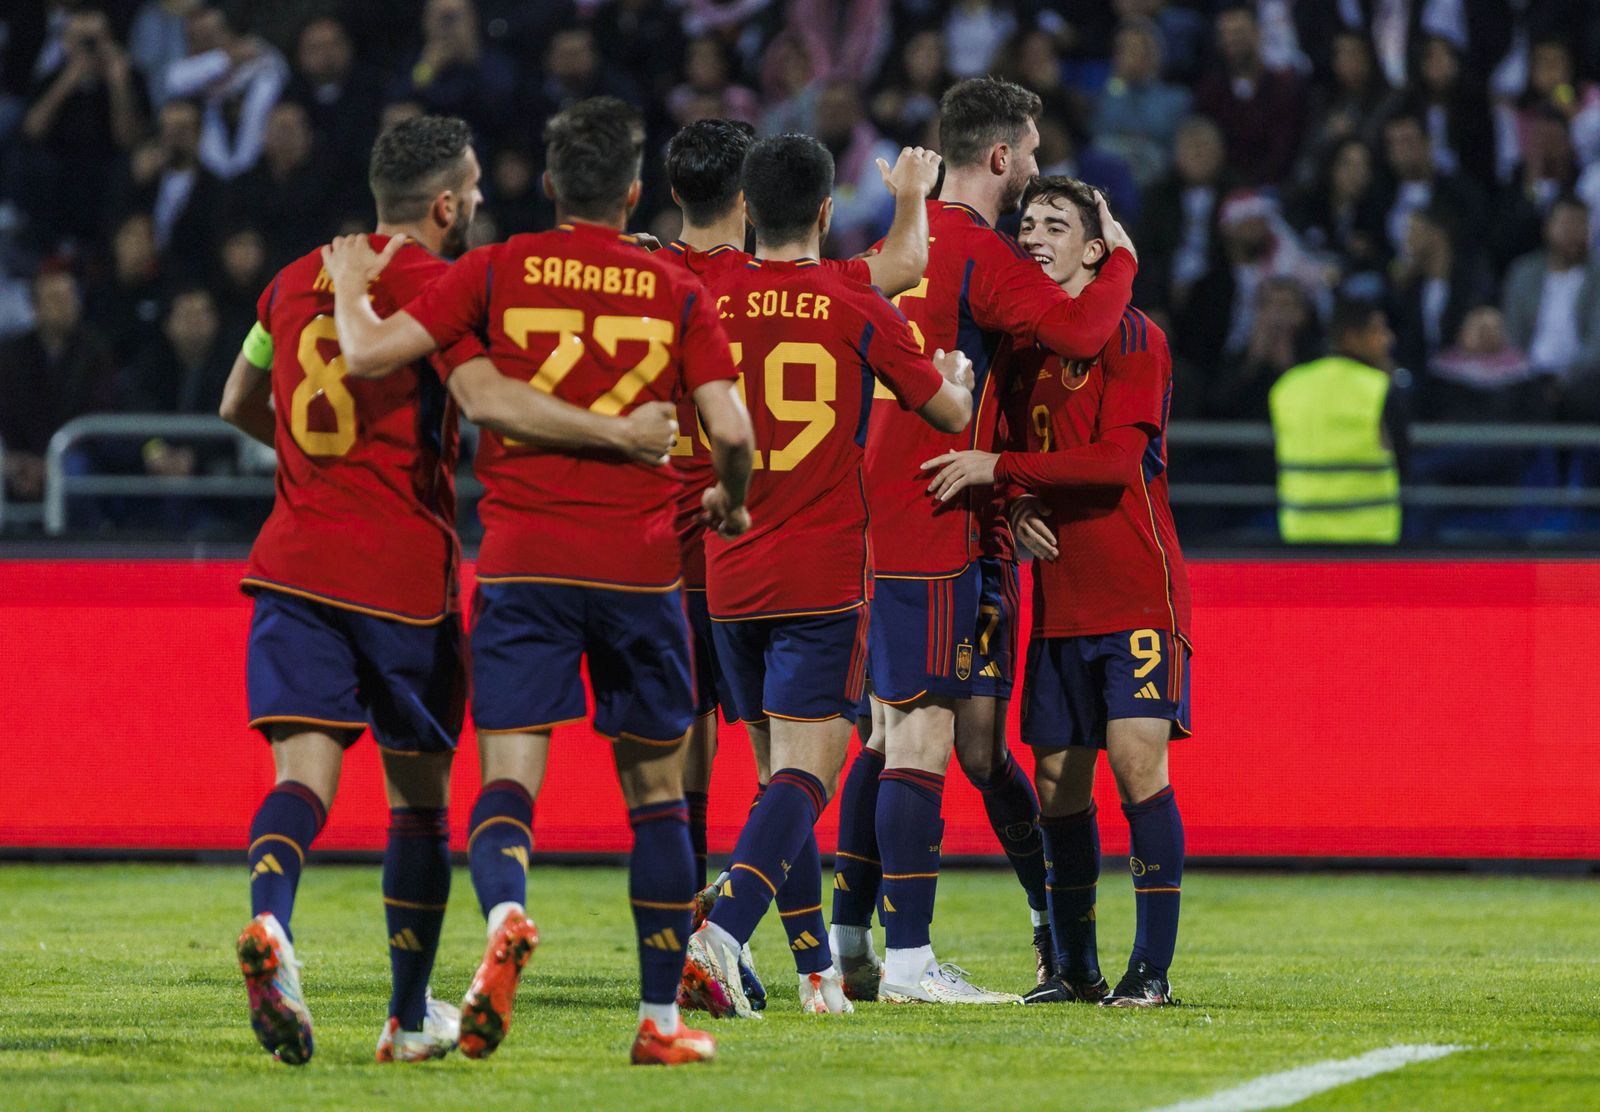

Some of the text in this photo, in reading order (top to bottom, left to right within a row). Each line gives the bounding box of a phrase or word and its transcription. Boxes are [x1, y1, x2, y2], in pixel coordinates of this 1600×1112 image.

[523, 256, 656, 299] SARABIA
[716, 290, 831, 320] C. SOLER
[291, 314, 356, 456] 8
[1032, 404, 1050, 453] 9
[1130, 628, 1161, 678] 9
